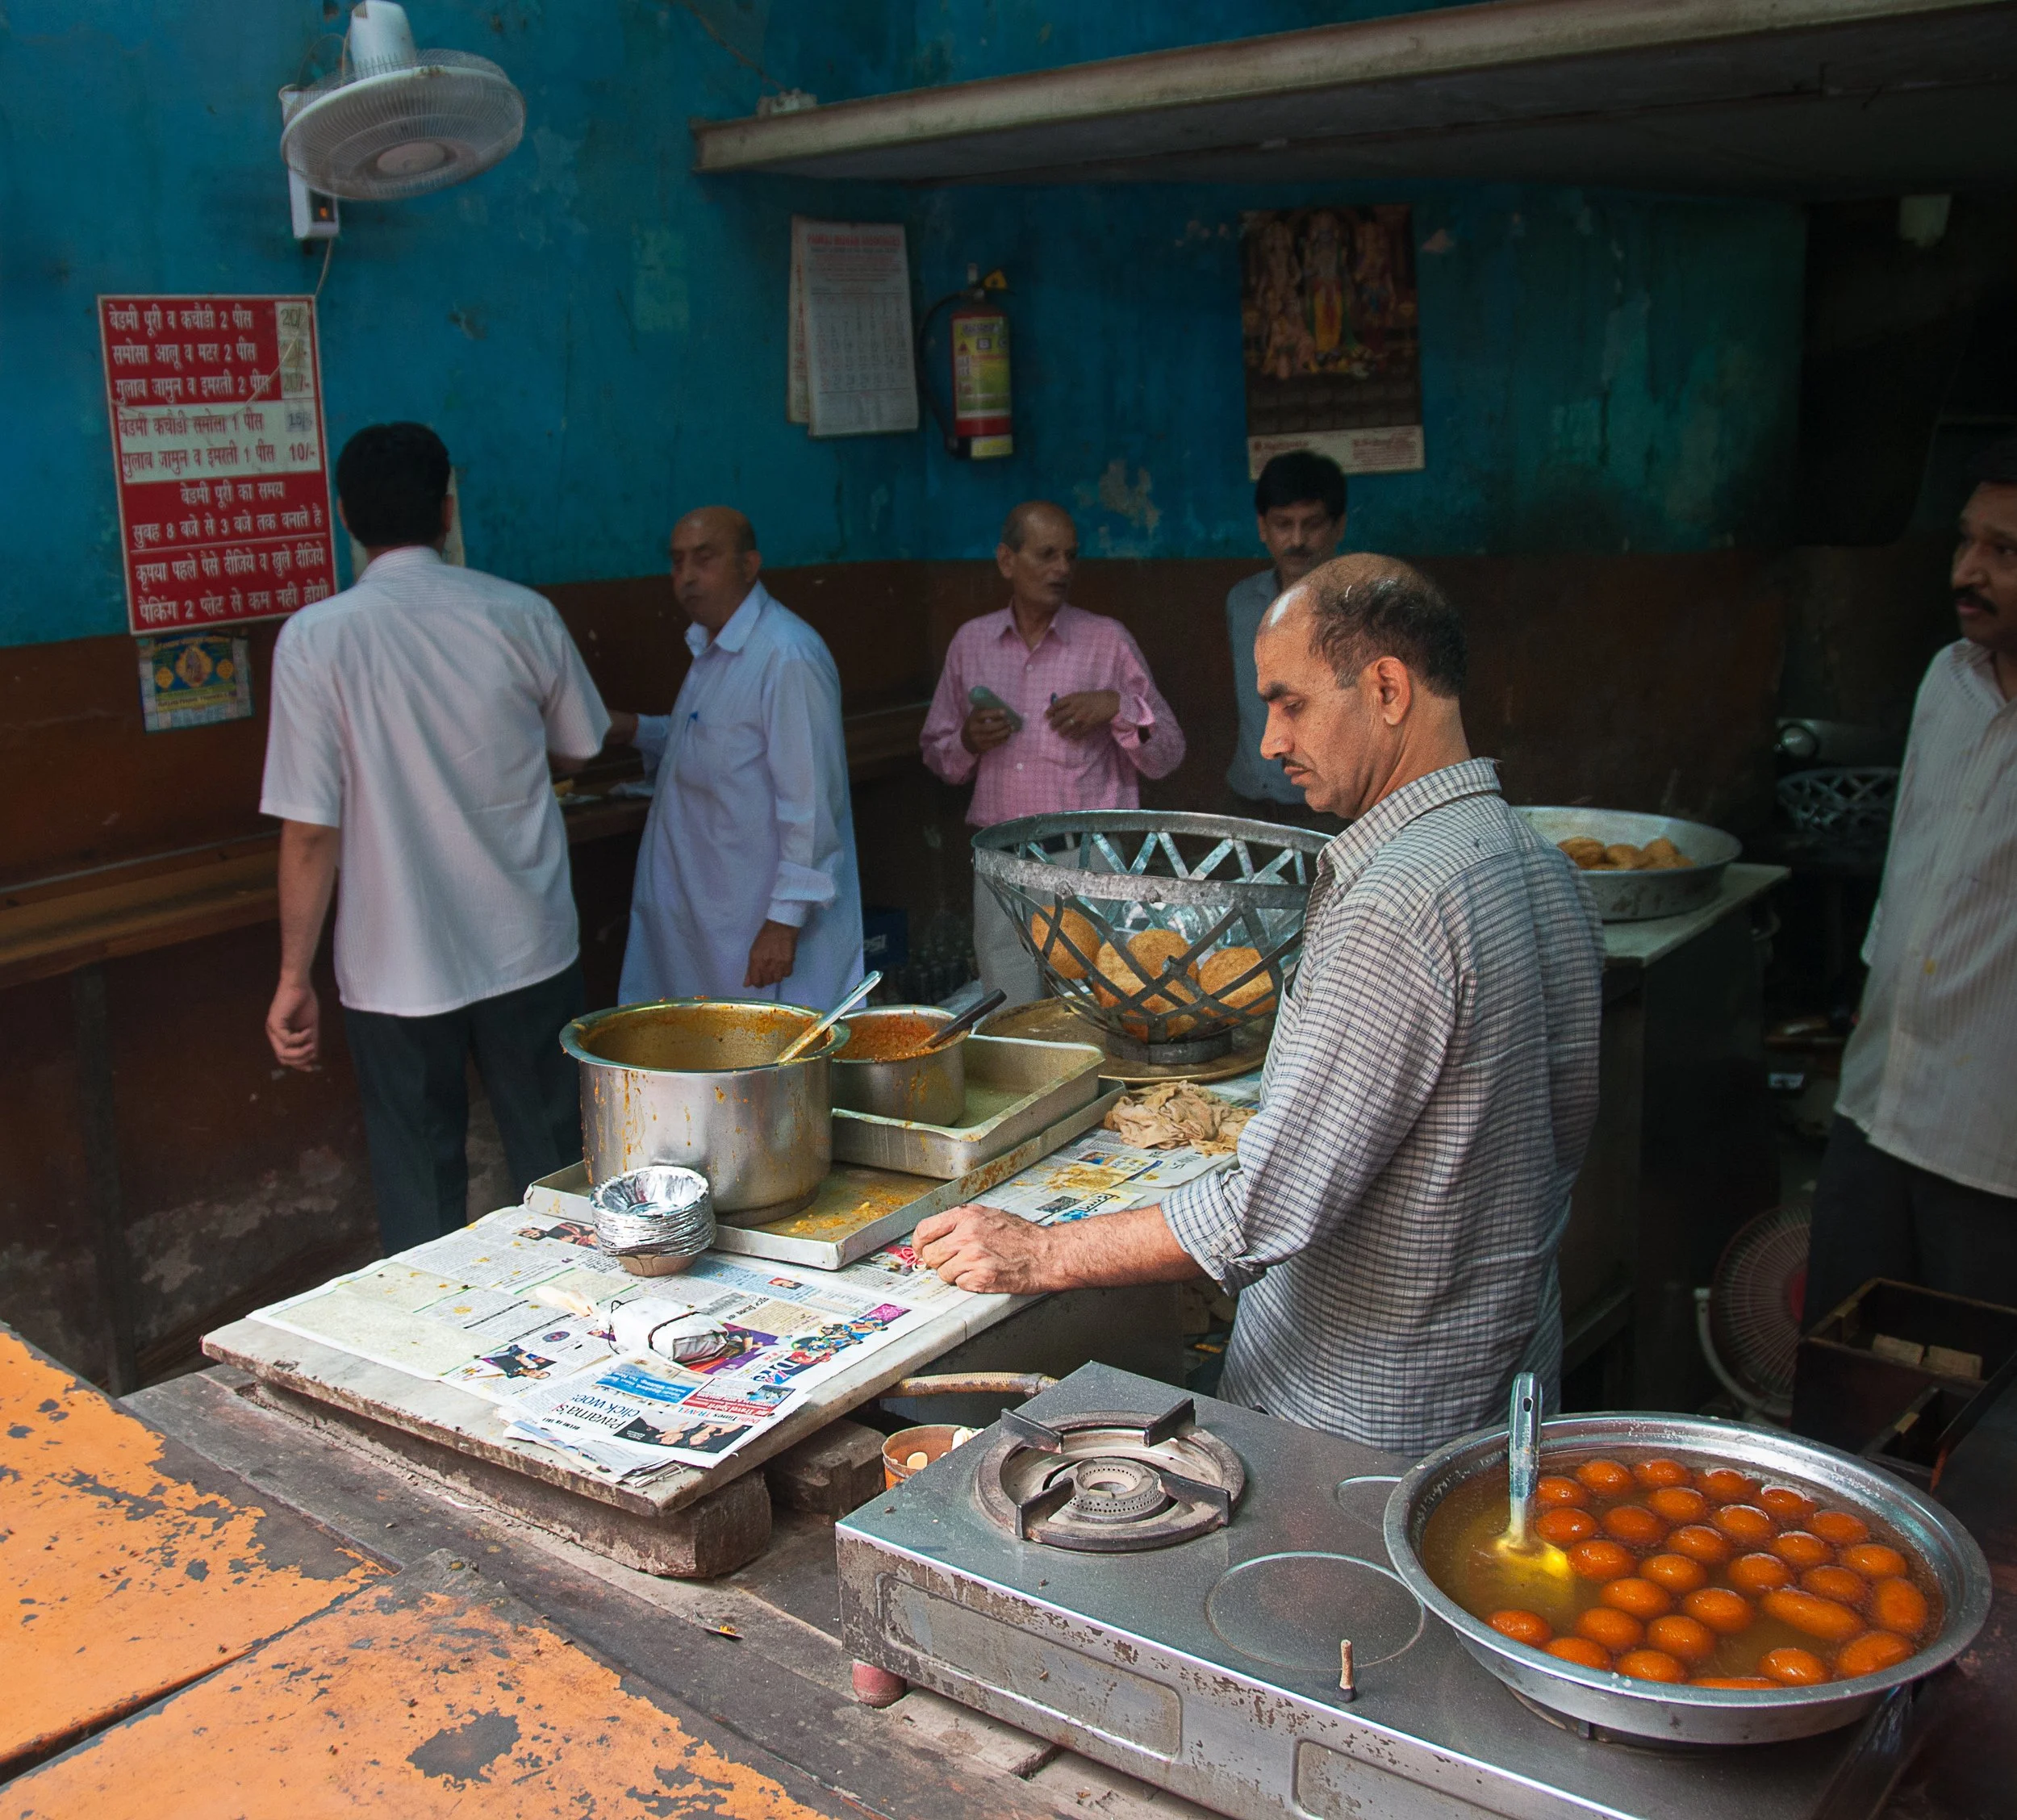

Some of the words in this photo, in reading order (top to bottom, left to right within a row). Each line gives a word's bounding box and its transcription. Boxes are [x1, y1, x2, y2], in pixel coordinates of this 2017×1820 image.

[144, 305, 162, 338] पूरी
[167, 310, 176, 329] व
[220, 311, 229, 329] 2
[232, 303, 254, 328] पीस
[111, 338, 149, 366] समोसा
[155, 344, 183, 370] आलू
[185, 344, 194, 362] व
[198, 343, 219, 361] मटर
[224, 344, 232, 363] 2
[236, 336, 258, 361] पीस
[152, 378, 182, 403] जामुन
[187, 377, 196, 395] व
[200, 369, 233, 398] इमरती
[238, 378, 246, 393] 2
[249, 369, 270, 394] पीस
[194, 409, 227, 433] समोसा
[232, 415, 238, 431] 1
[244, 407, 264, 432] पीस
[159, 450, 188, 474] जामुन
[194, 449, 202, 465] व
[207, 440, 238, 467] इमरती
[244, 449, 249, 462] 1
[257, 438, 274, 463] पीस
[215, 479, 233, 510] पूरी
[238, 483, 254, 502] का
[257, 482, 285, 500] समय
[132, 523, 161, 549] सुबह
[166, 525, 175, 539] 8
[180, 513, 199, 538] बजे
[205, 512, 215, 536] से
[221, 519, 228, 535] 3
[234, 509, 252, 534] बजे
[257, 513, 276, 532] तक
[136, 563, 167, 593] कृपया
[172, 553, 197, 581] पहले
[201, 550, 220, 577] पैसे
[223, 547, 256, 575] दीजिये
[260, 553, 269, 572] व
[272, 544, 291, 579] खुले
[295, 541, 325, 568] दीजिये
[139, 595, 178, 624] पैकिंग
[185, 601, 195, 619] 2
[200, 591, 226, 616] प्लेट
[230, 587, 243, 613] से
[248, 591, 271, 611] कम
[303, 578, 328, 604] होगी
[606, 1403, 641, 1418] click
[678, 1407, 711, 1418] TRAVEL
[713, 1413, 738, 1421] Times
